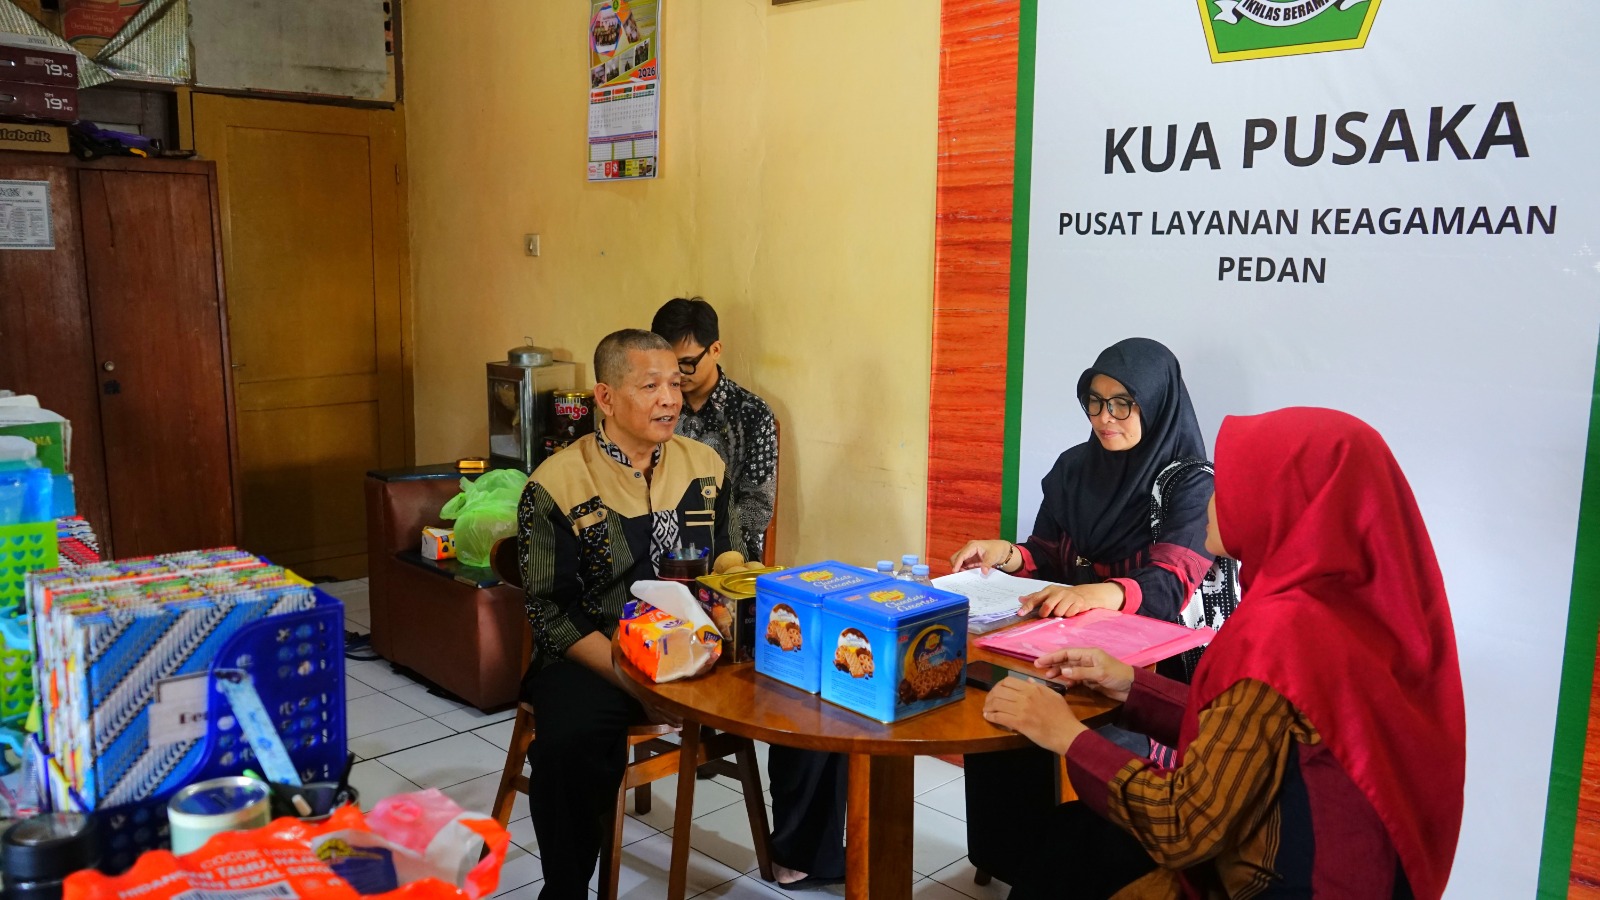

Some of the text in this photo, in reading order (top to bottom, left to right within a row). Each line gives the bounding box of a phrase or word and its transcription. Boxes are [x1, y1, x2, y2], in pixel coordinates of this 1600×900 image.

[1242, 0, 1281, 21] IKHLAS
[638, 67, 656, 78] 2026
[0, 128, 52, 142] labaik
[1104, 101, 1530, 175] KUA PUSAKA
[1058, 205, 1557, 236] PUSAT LAYANAN KEAGAMAAN
[1218, 256, 1327, 283] PEDAN
[555, 403, 588, 420] Tango
